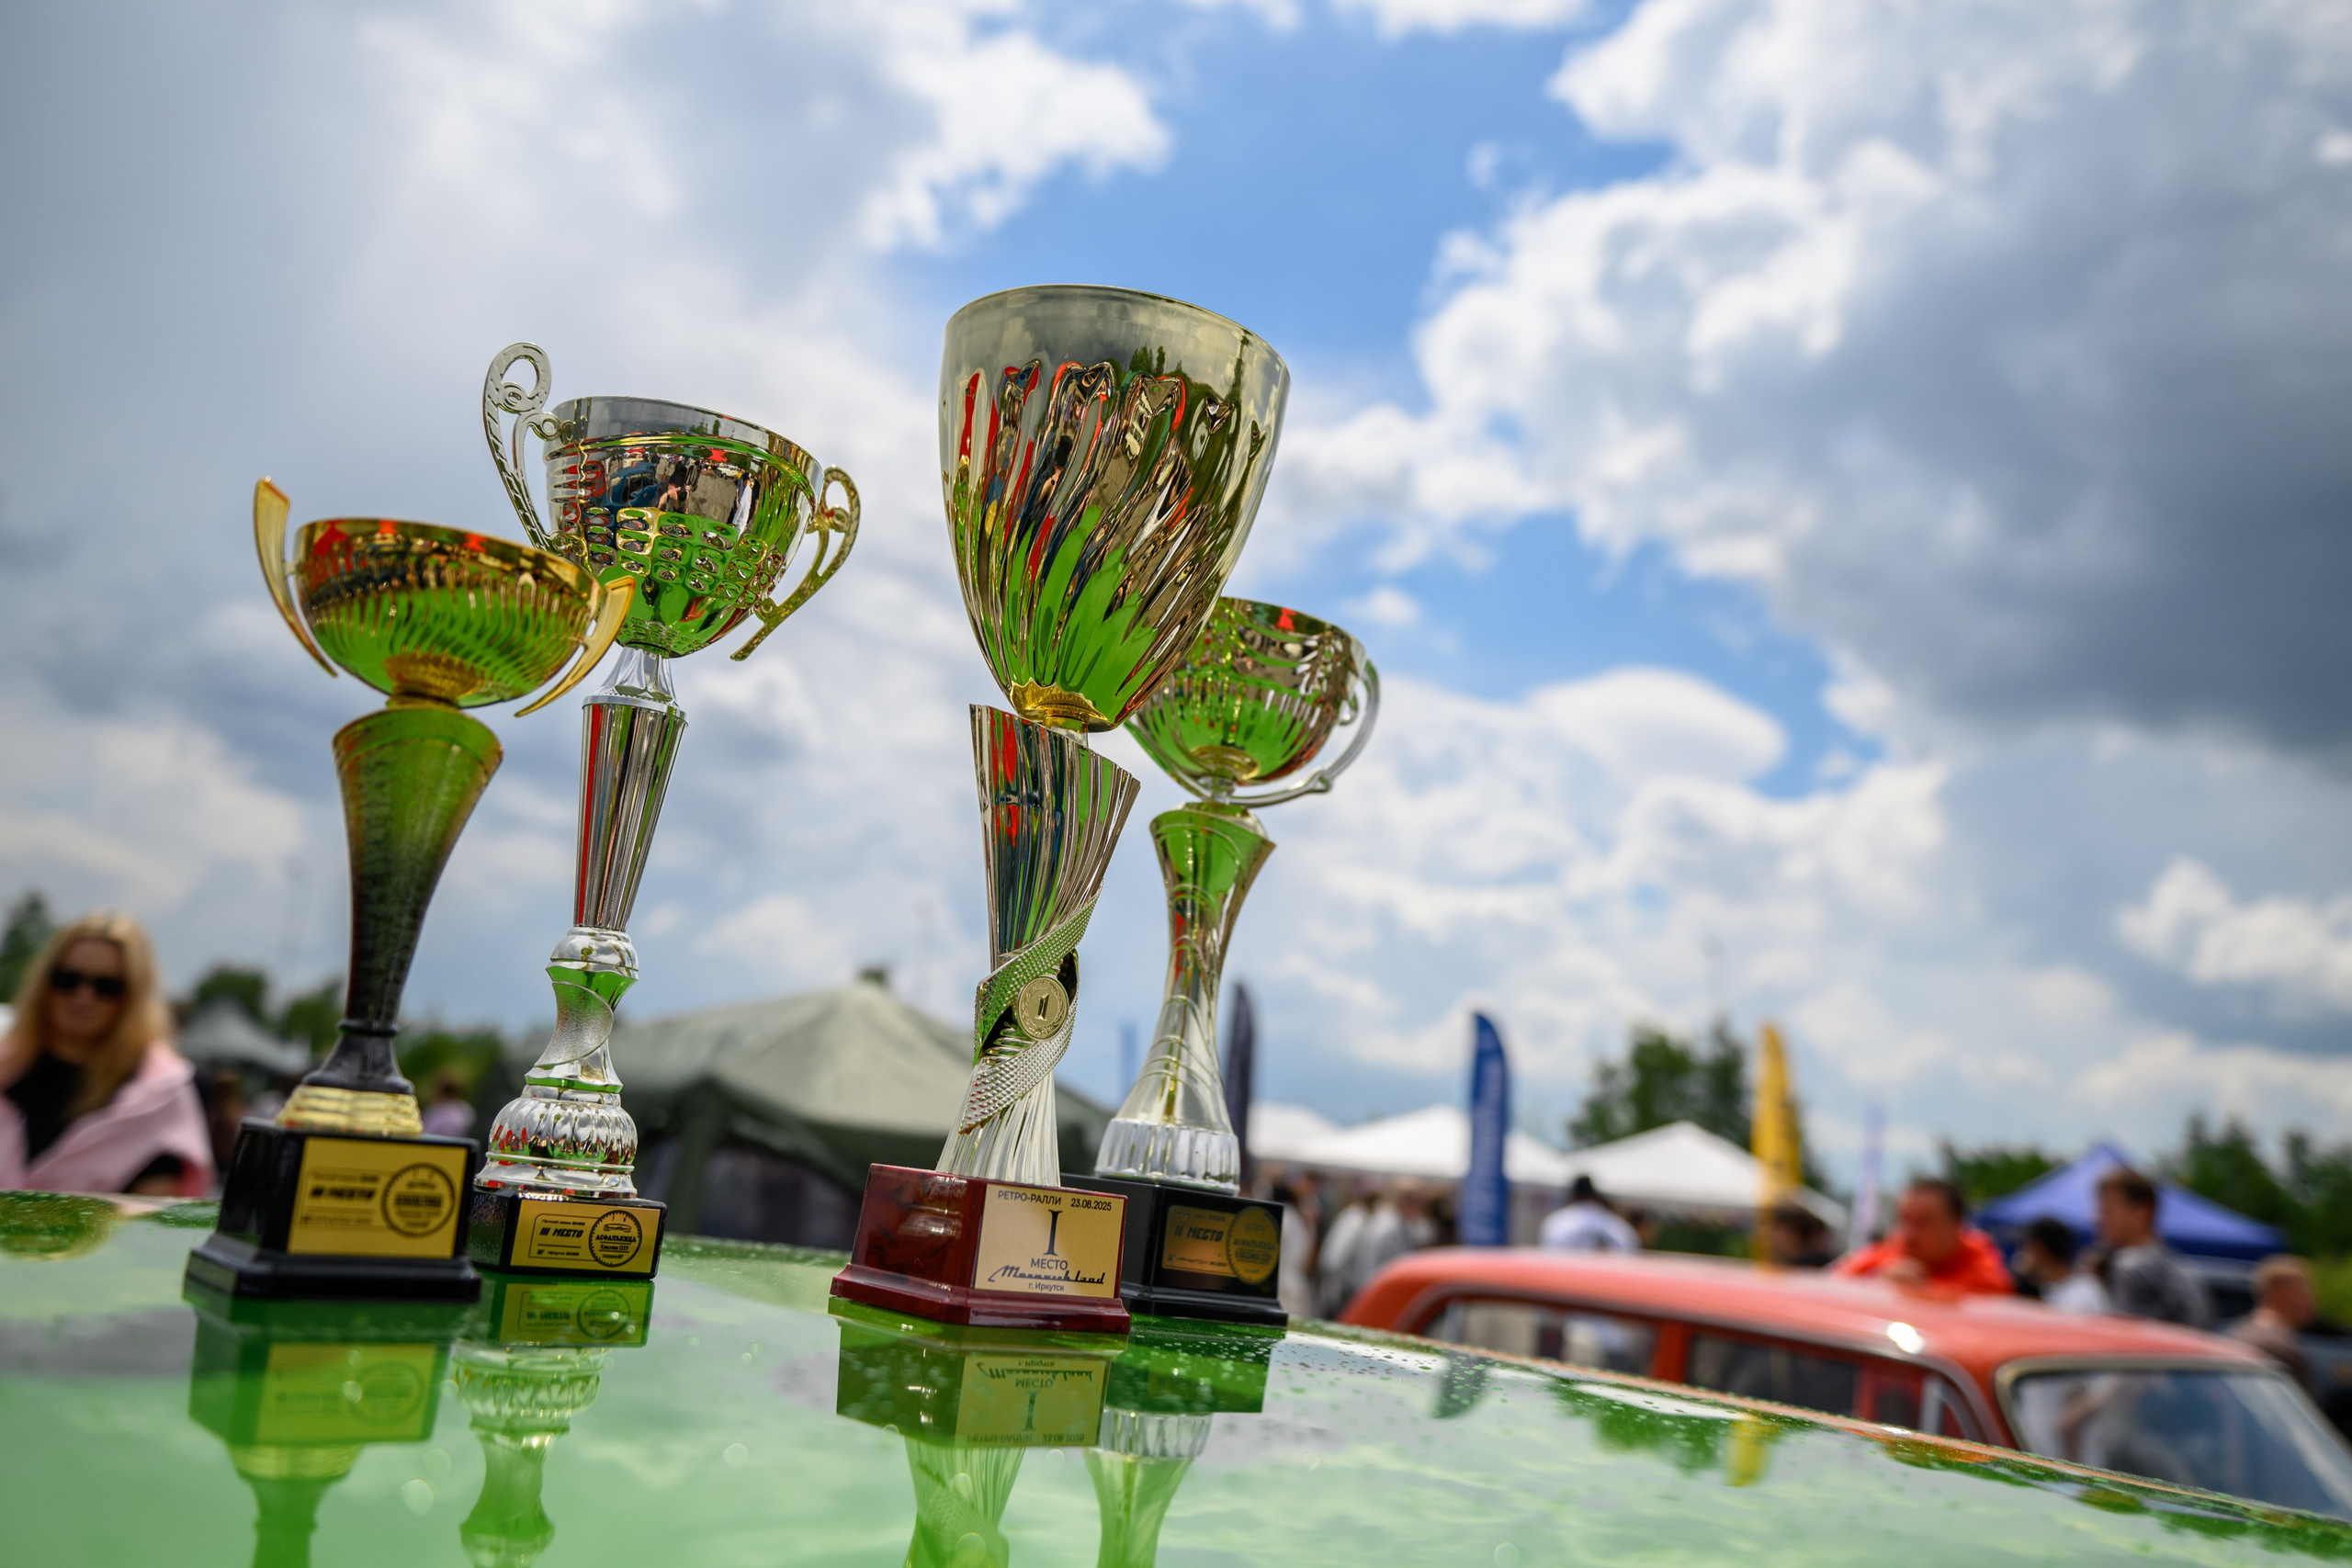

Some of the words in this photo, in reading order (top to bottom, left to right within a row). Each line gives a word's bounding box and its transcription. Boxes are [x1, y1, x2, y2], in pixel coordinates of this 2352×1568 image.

[998, 1190, 1062, 1206] РЕТРО-РАЛЛИ
[1070, 1198, 1113, 1212] 23.08.2025
[552, 1227, 584, 1238] МЕСТО
[1173, 1224, 1183, 1237] II
[1186, 1226, 1224, 1243] МЕСТО
[1031, 1258, 1069, 1270] МЕСТО
[1035, 1282, 1065, 1292] Иркутск
